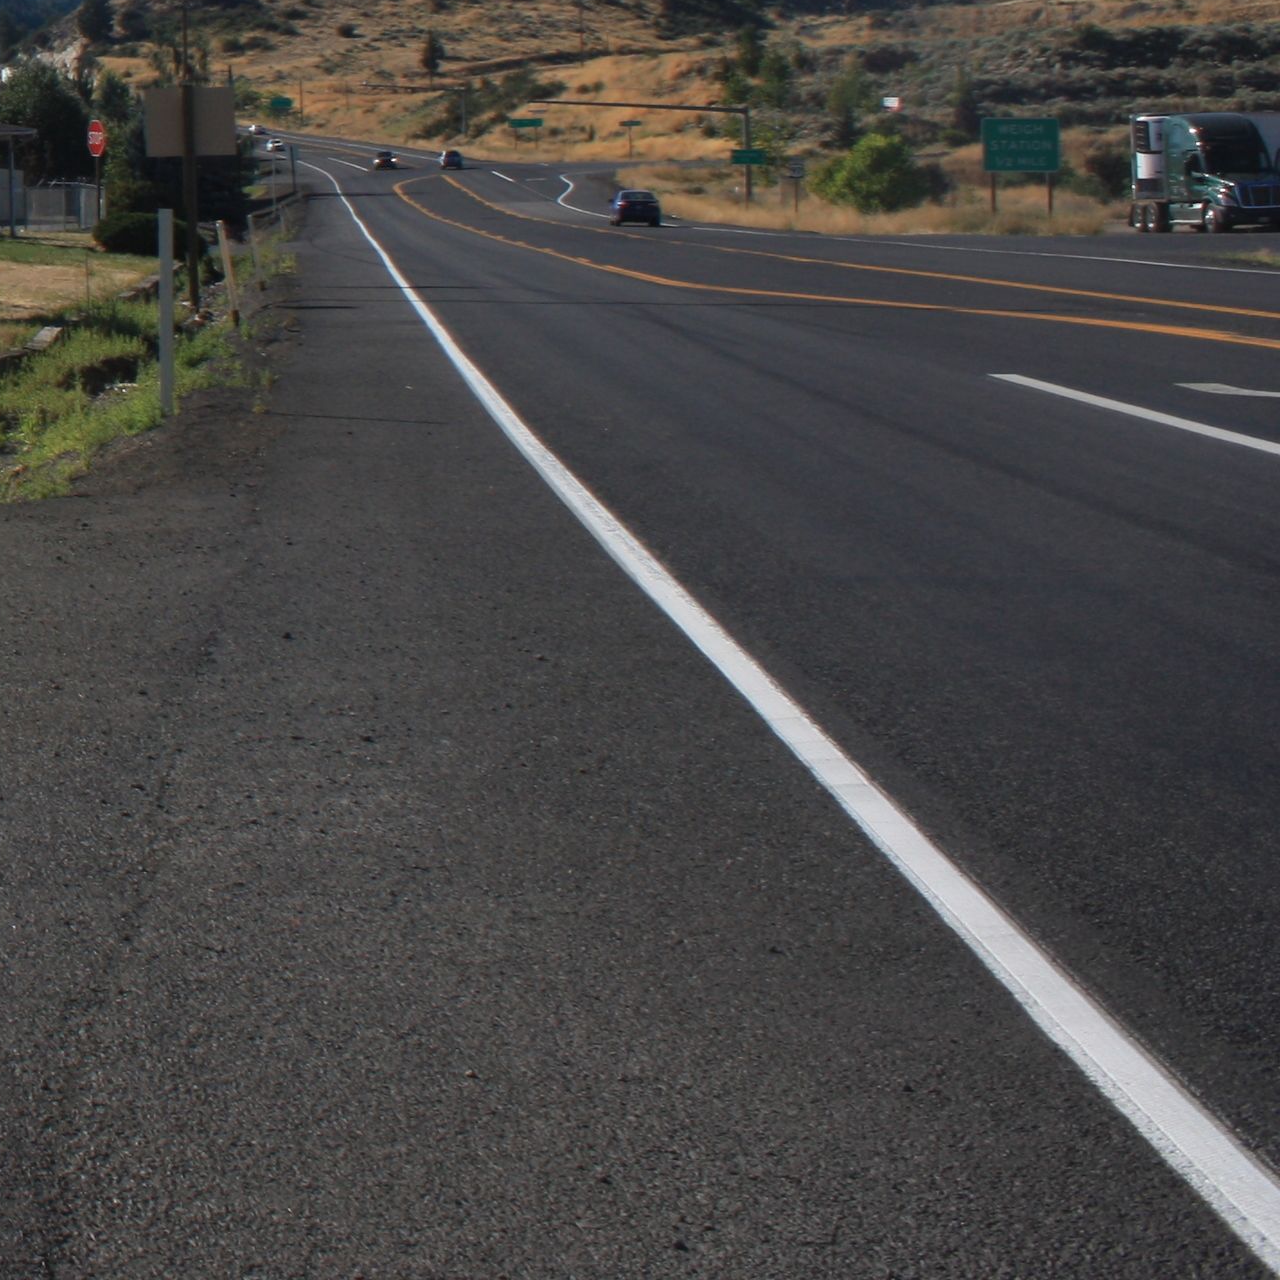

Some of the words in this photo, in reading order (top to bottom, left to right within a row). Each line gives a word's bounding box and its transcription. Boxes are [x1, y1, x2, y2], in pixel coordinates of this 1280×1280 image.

[997, 123, 1044, 135] WEIGH
[88, 131, 103, 145] STOP
[989, 140, 1053, 151] STATION
